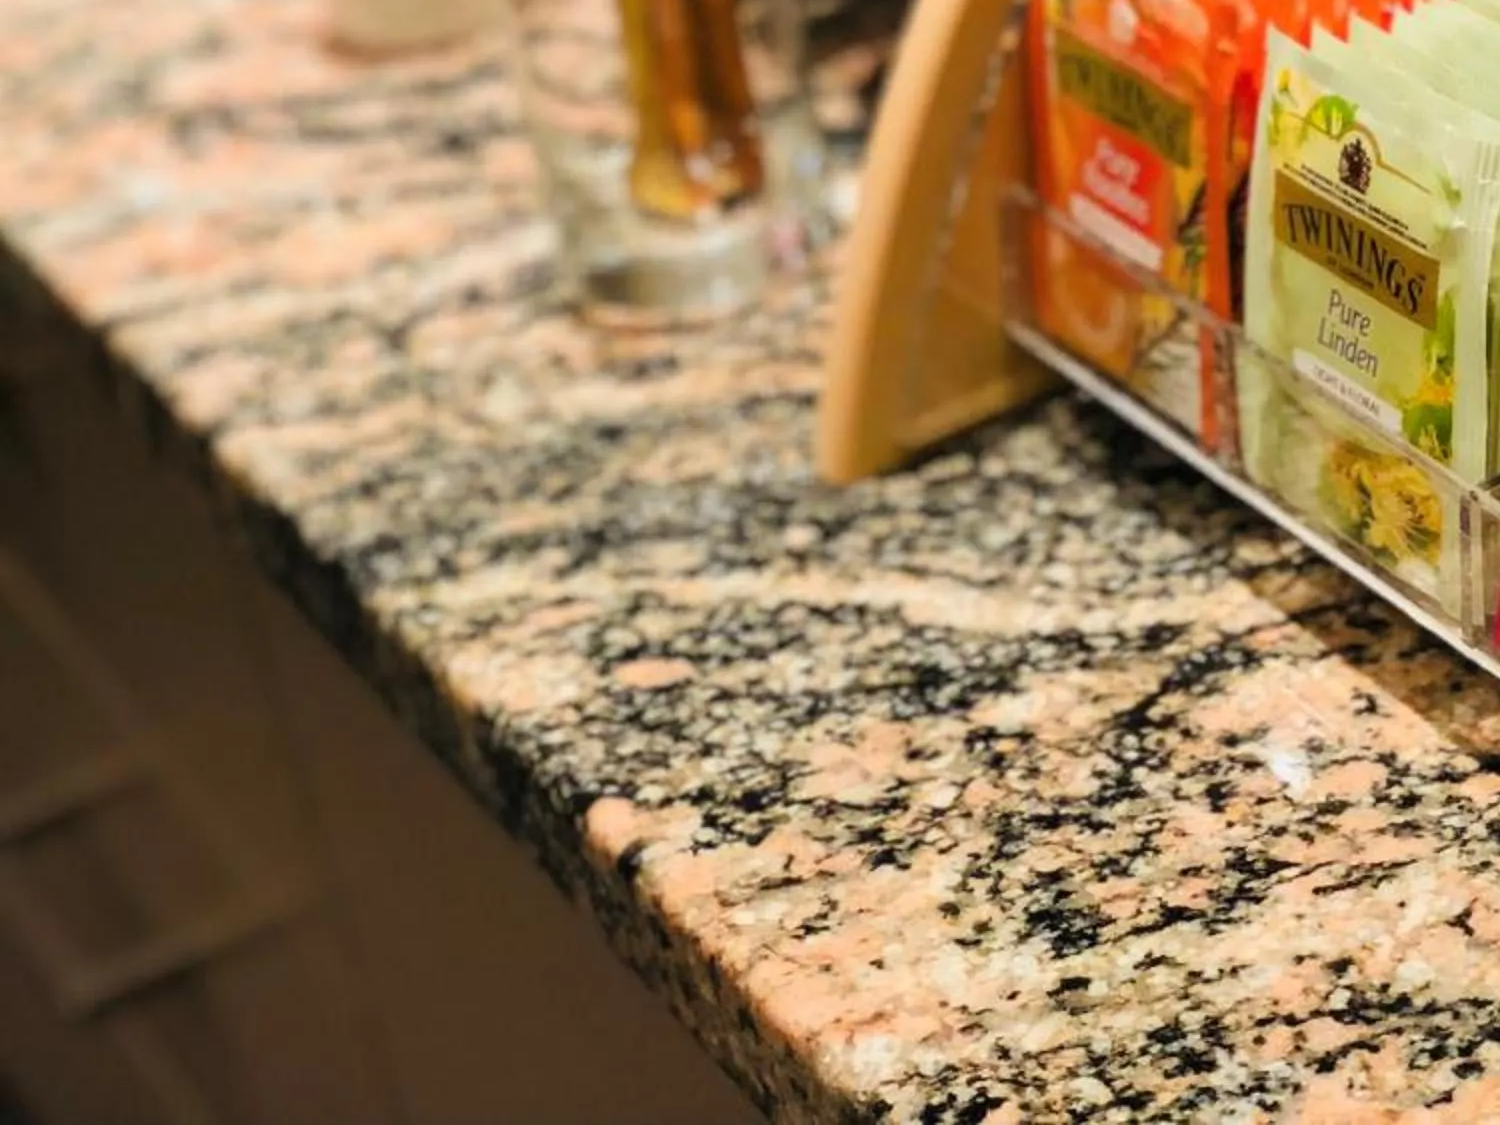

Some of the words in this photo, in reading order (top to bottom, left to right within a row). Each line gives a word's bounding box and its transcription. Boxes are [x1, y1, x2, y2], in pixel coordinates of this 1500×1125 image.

[1282, 203, 1424, 317] TWININGS
[1327, 288, 1372, 338] Pure
[1316, 316, 1380, 379] Linden
